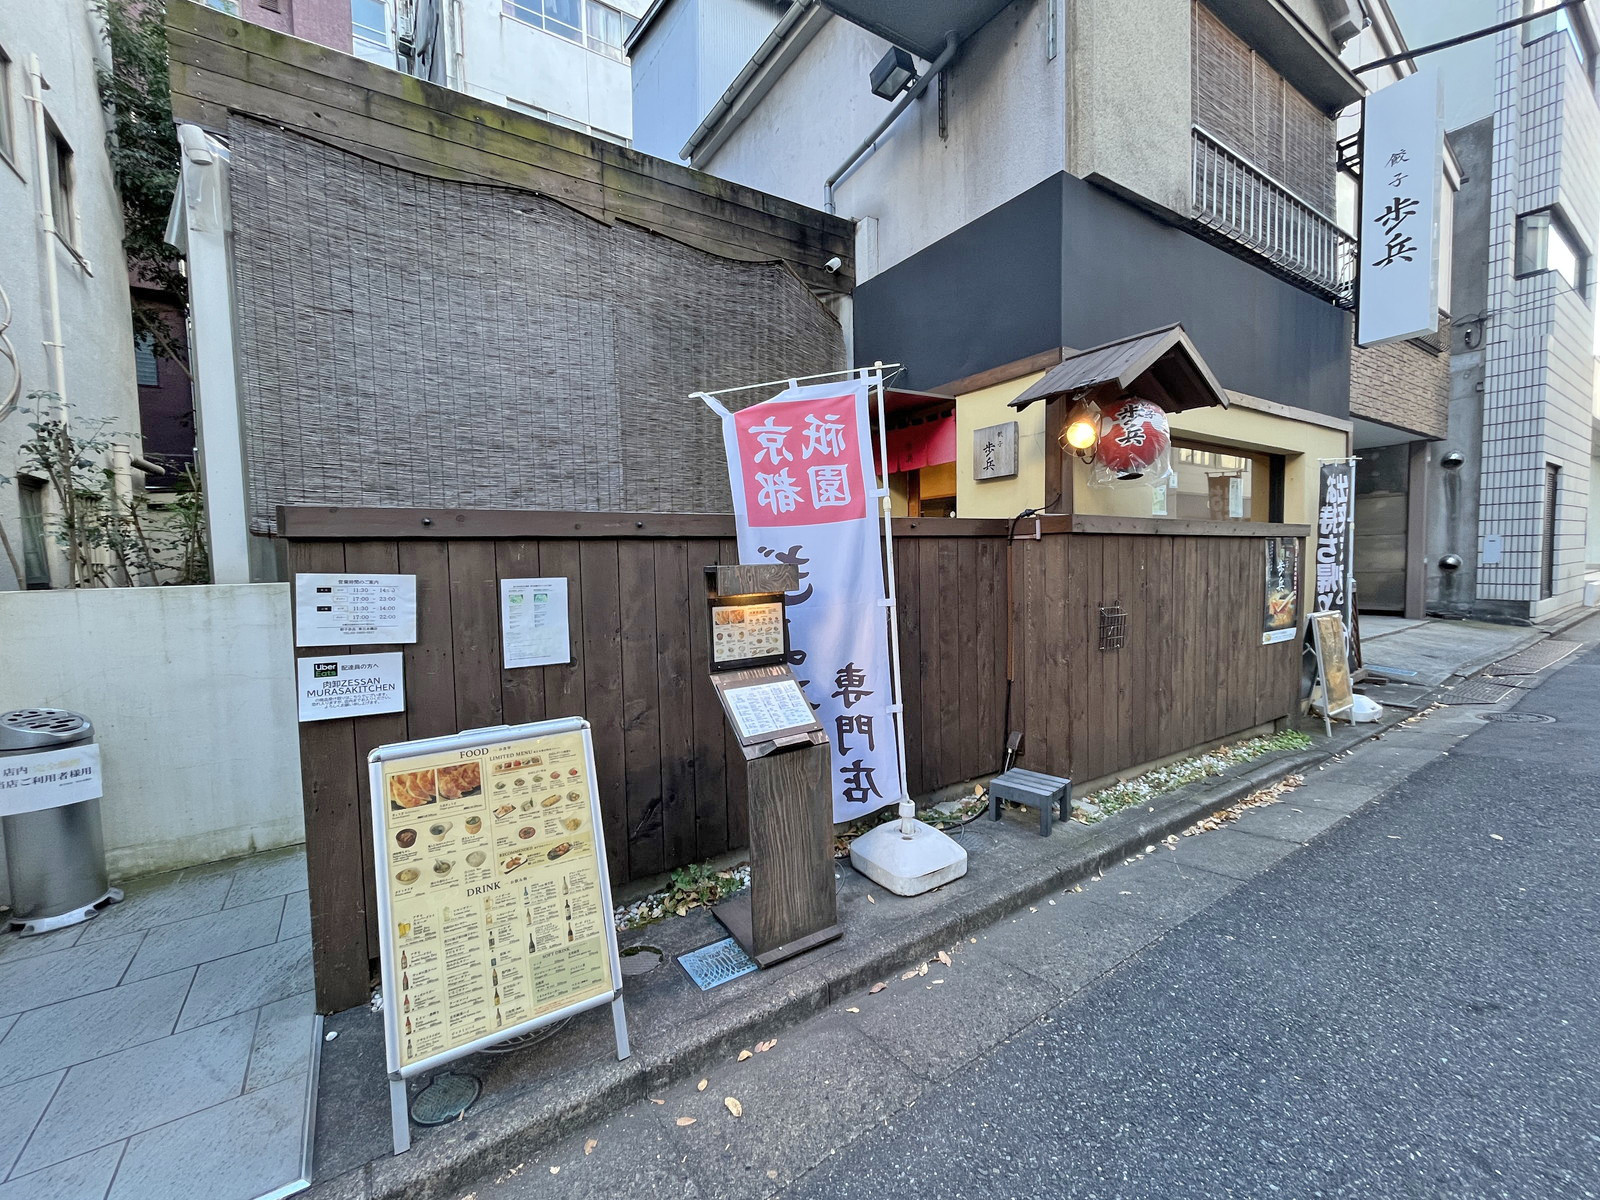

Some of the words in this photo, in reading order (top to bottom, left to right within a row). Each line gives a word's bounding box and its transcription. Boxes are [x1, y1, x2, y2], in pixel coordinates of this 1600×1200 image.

[1384, 148, 1411, 188] 餃子
[1371, 196, 1420, 270] 歩兵
[1116, 404, 1145, 446] 歩兵
[982, 441, 996, 471] 歩兵
[341, 663, 379, 671] 配達員の方へ
[307, 683, 396, 698] MURASAKITCHEN
[459, 747, 490, 760] FOOD
[489, 753, 514, 762] LIMITED
[515, 749, 534, 759] MENU
[3, 766, 29, 777] 店内
[466, 881, 501, 898] DRINK
[554, 947, 571, 955] DRINK
